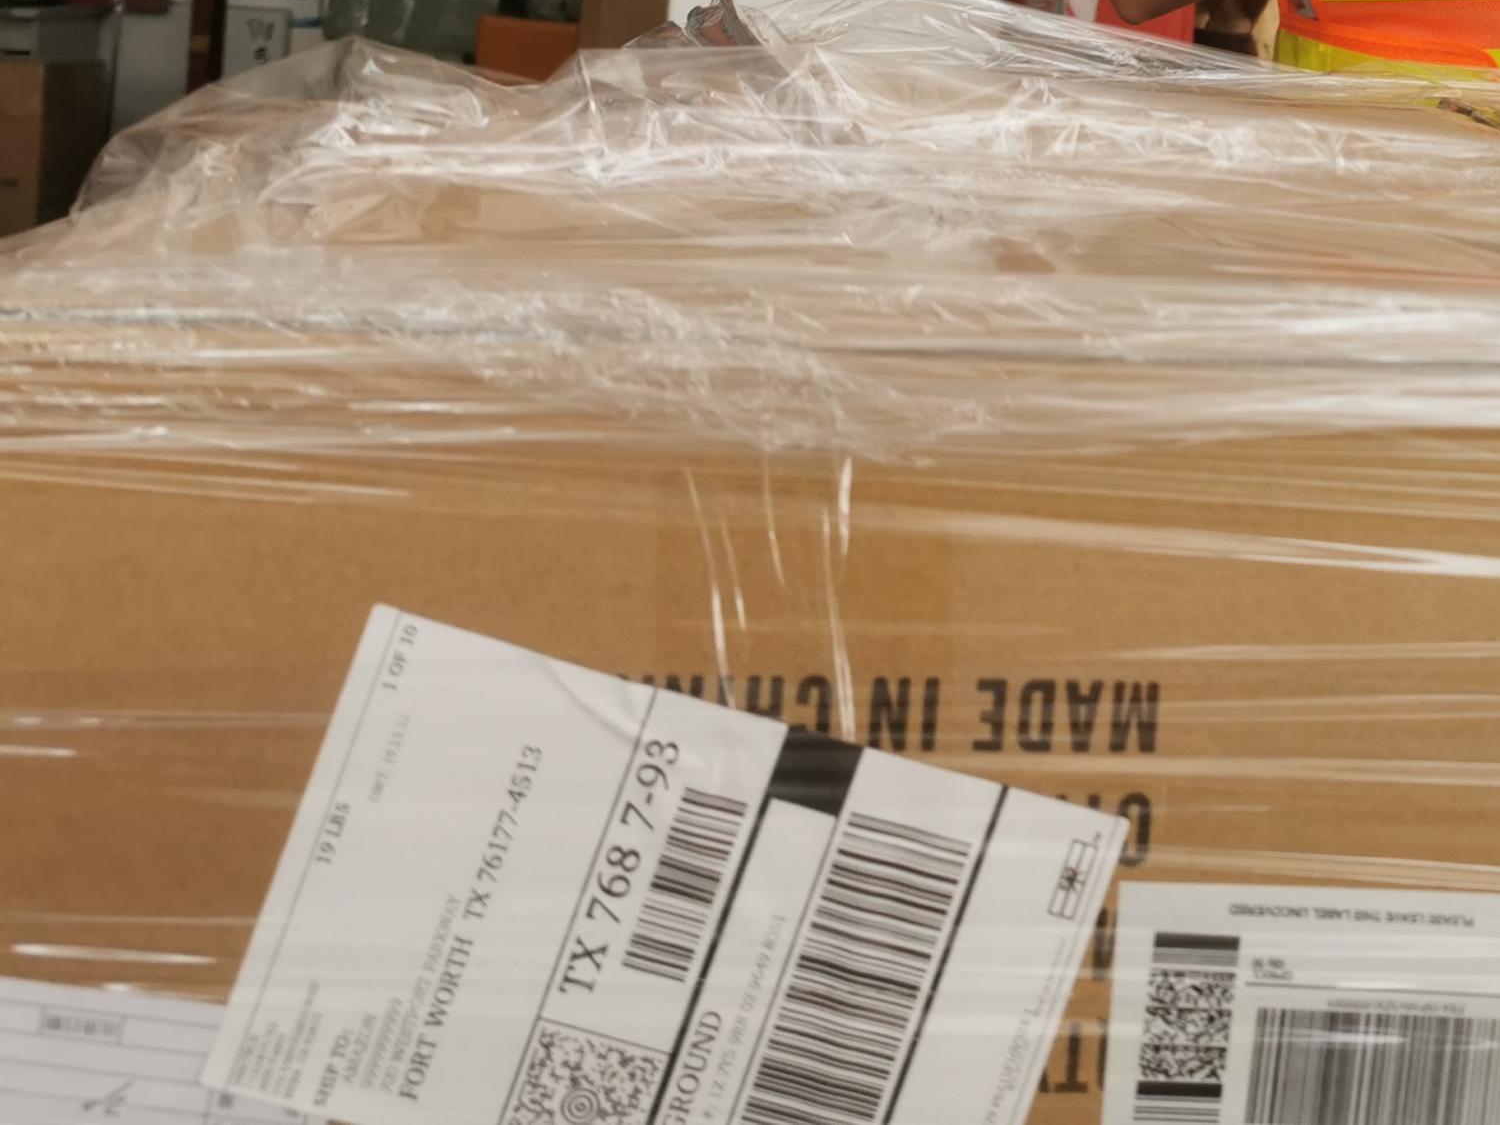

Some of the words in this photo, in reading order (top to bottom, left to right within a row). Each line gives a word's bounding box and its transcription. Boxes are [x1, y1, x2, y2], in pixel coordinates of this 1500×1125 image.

[386, 648, 410, 679] OF
[868, 677, 939, 751] IN
[975, 678, 1159, 752] MADE
[616, 732, 684, 835] 7-93
[324, 799, 352, 840] LBS
[475, 743, 546, 885] 76177-4513
[314, 839, 338, 866] 19
[462, 886, 492, 924] TX
[582, 840, 644, 927] 768
[1228, 902, 1308, 919] UNCOVERED
[1312, 906, 1350, 921] LABEL
[1353, 909, 1380, 923] THIS
[1385, 910, 1424, 925] LEAVE
[1427, 912, 1474, 928] PLEASE
[422, 933, 476, 1031] WORTH
[556, 933, 610, 1002] TX
[396, 1031, 440, 1102] FORT
[660, 1010, 723, 1125] GROUND
